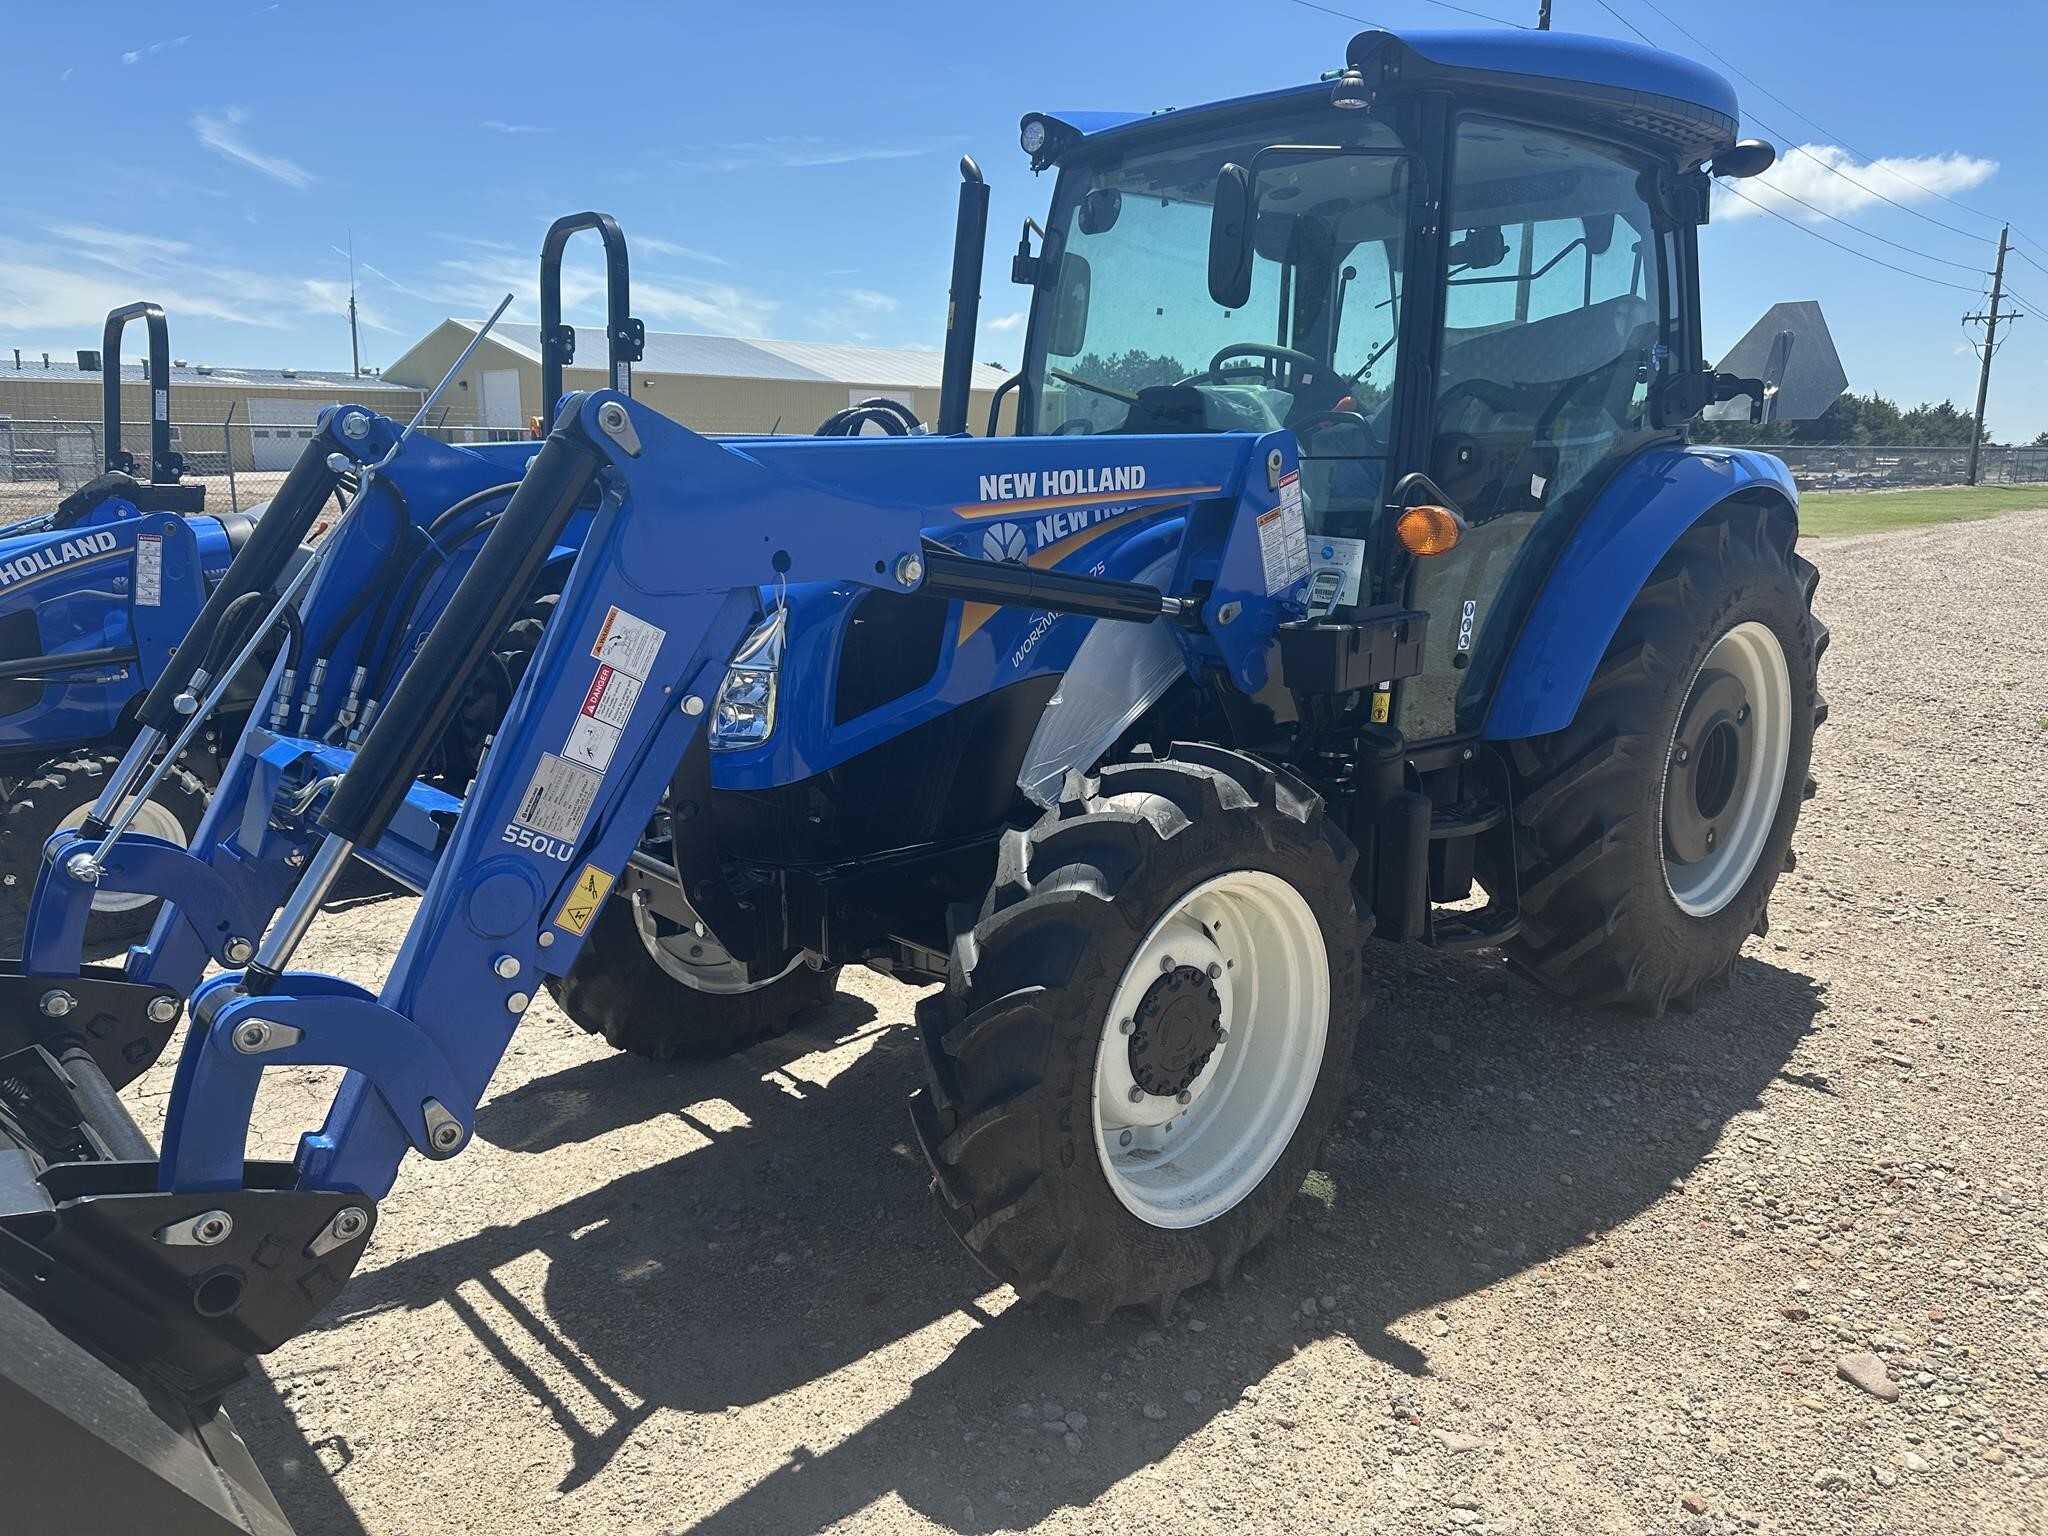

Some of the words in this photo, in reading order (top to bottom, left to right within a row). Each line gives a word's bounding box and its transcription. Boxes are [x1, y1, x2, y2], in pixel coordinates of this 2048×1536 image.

[980, 472, 1037, 501] NEW
[1042, 465, 1146, 496] HOLLAND
[1035, 511, 1088, 548] NEW
[0, 531, 117, 586] HOLLAND
[599, 611, 617, 645] WARNING
[1011, 610, 1065, 668] WORKM
[1089, 560, 1106, 577] 75
[590, 669, 610, 704] DANGER
[501, 824, 574, 862] 550LU
